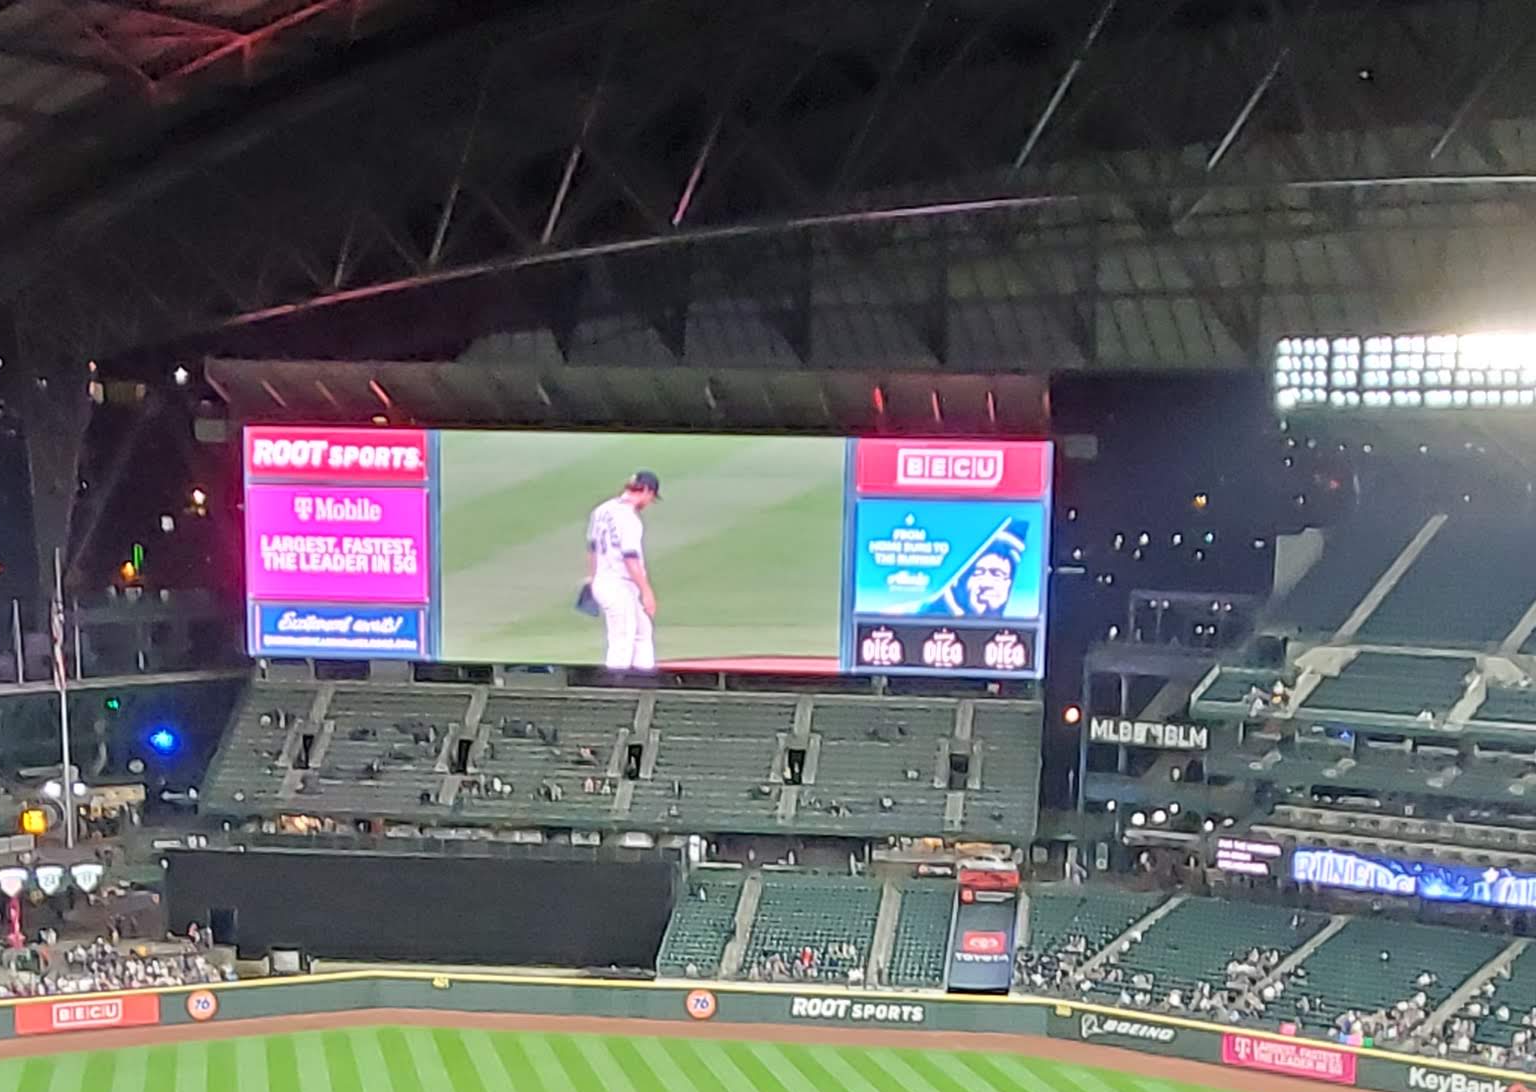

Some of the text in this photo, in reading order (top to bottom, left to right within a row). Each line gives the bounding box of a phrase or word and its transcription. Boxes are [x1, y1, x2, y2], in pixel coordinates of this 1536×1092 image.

[253, 439, 328, 466] ROOT
[906, 456, 995, 479] BECU
[314, 497, 382, 521] Mobile
[300, 553, 370, 573] LEADER
[370, 555, 391, 574] IN
[1091, 717, 1209, 748] MLB BLM
[57, 1004, 118, 1022] BECU
[194, 998, 210, 1011] 76
[692, 997, 710, 1010] 76
[792, 998, 924, 1022] ROOT SPORTS
[1104, 1019, 1175, 1041] BOEING
